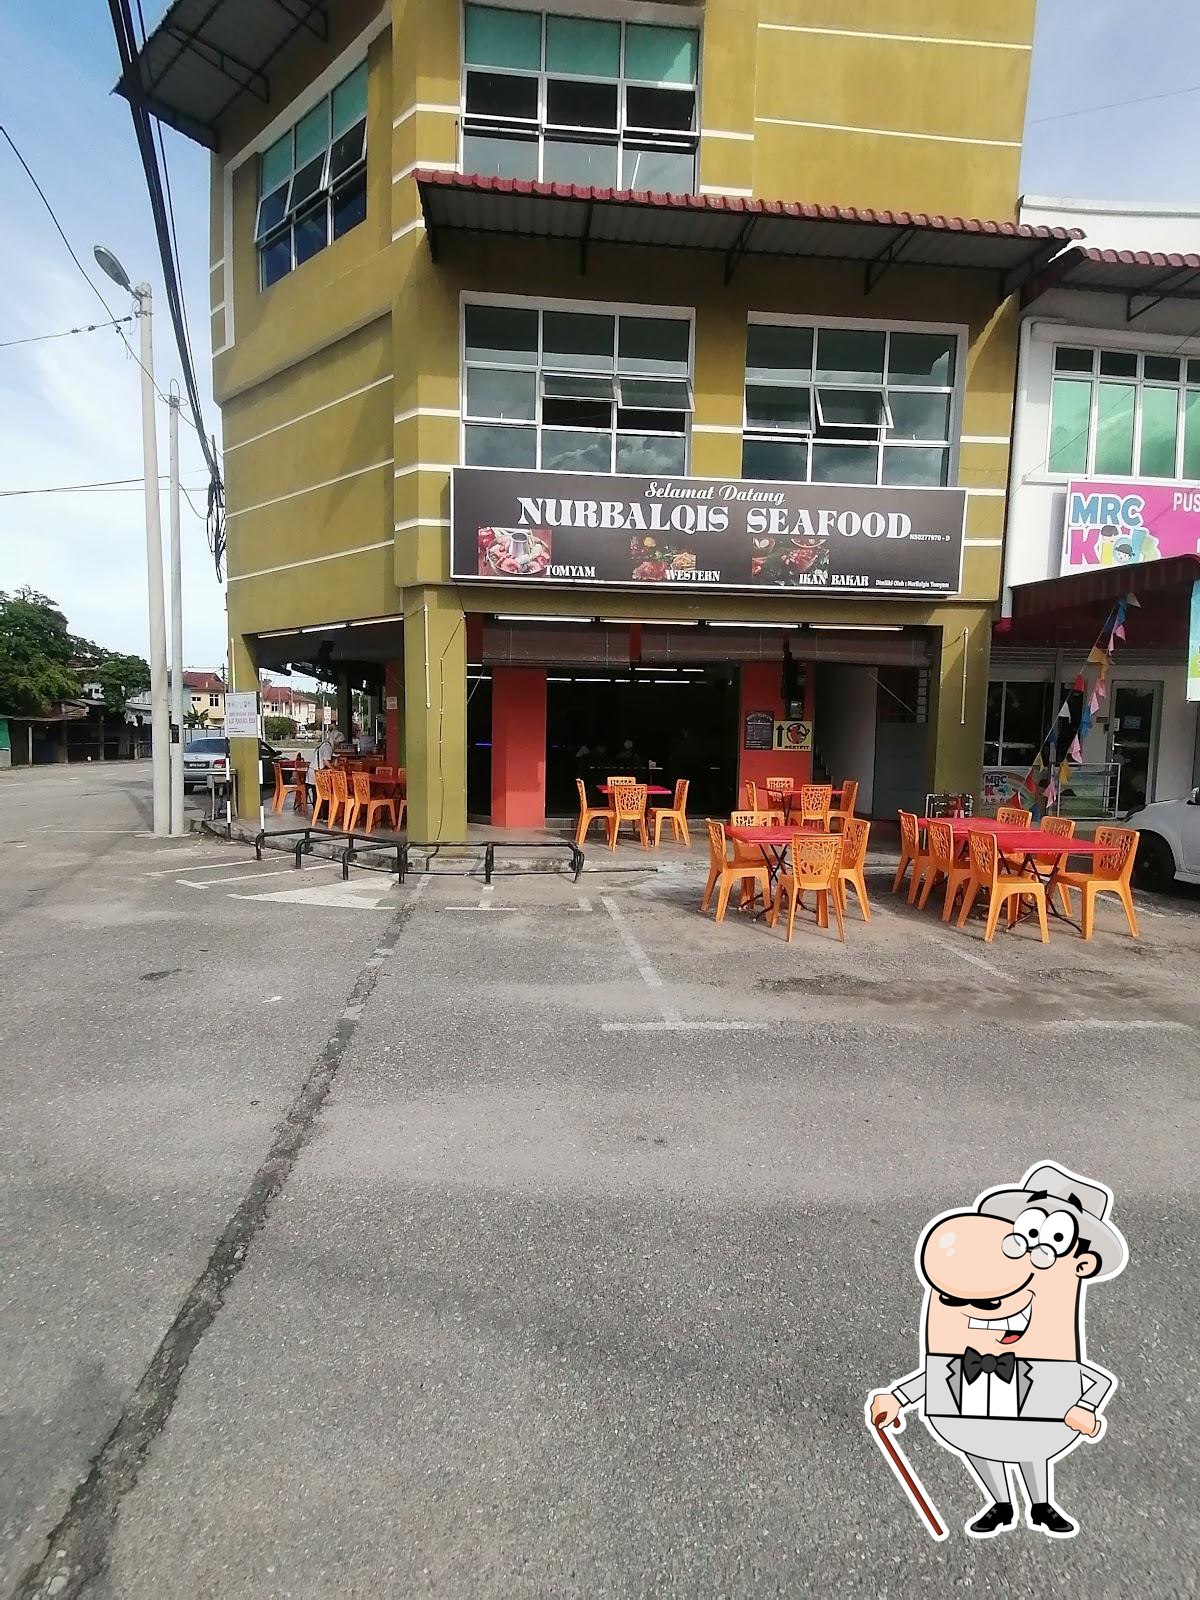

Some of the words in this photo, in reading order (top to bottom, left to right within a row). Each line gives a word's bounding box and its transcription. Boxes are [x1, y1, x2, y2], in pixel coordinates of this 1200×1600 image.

[644, 481, 715, 500] Selamat
[718, 484, 785, 506] Datang
[517, 497, 729, 534] NURBALQIS
[746, 507, 912, 539] SEAFOOD
[1071, 495, 1143, 527] MRC
[544, 564, 596, 578] TOMYAM
[665, 569, 721, 582] WESTERN
[799, 573, 828, 586] IKAN
[831, 575, 869, 587] BAKAR
[985, 775, 1007, 784] MRC
